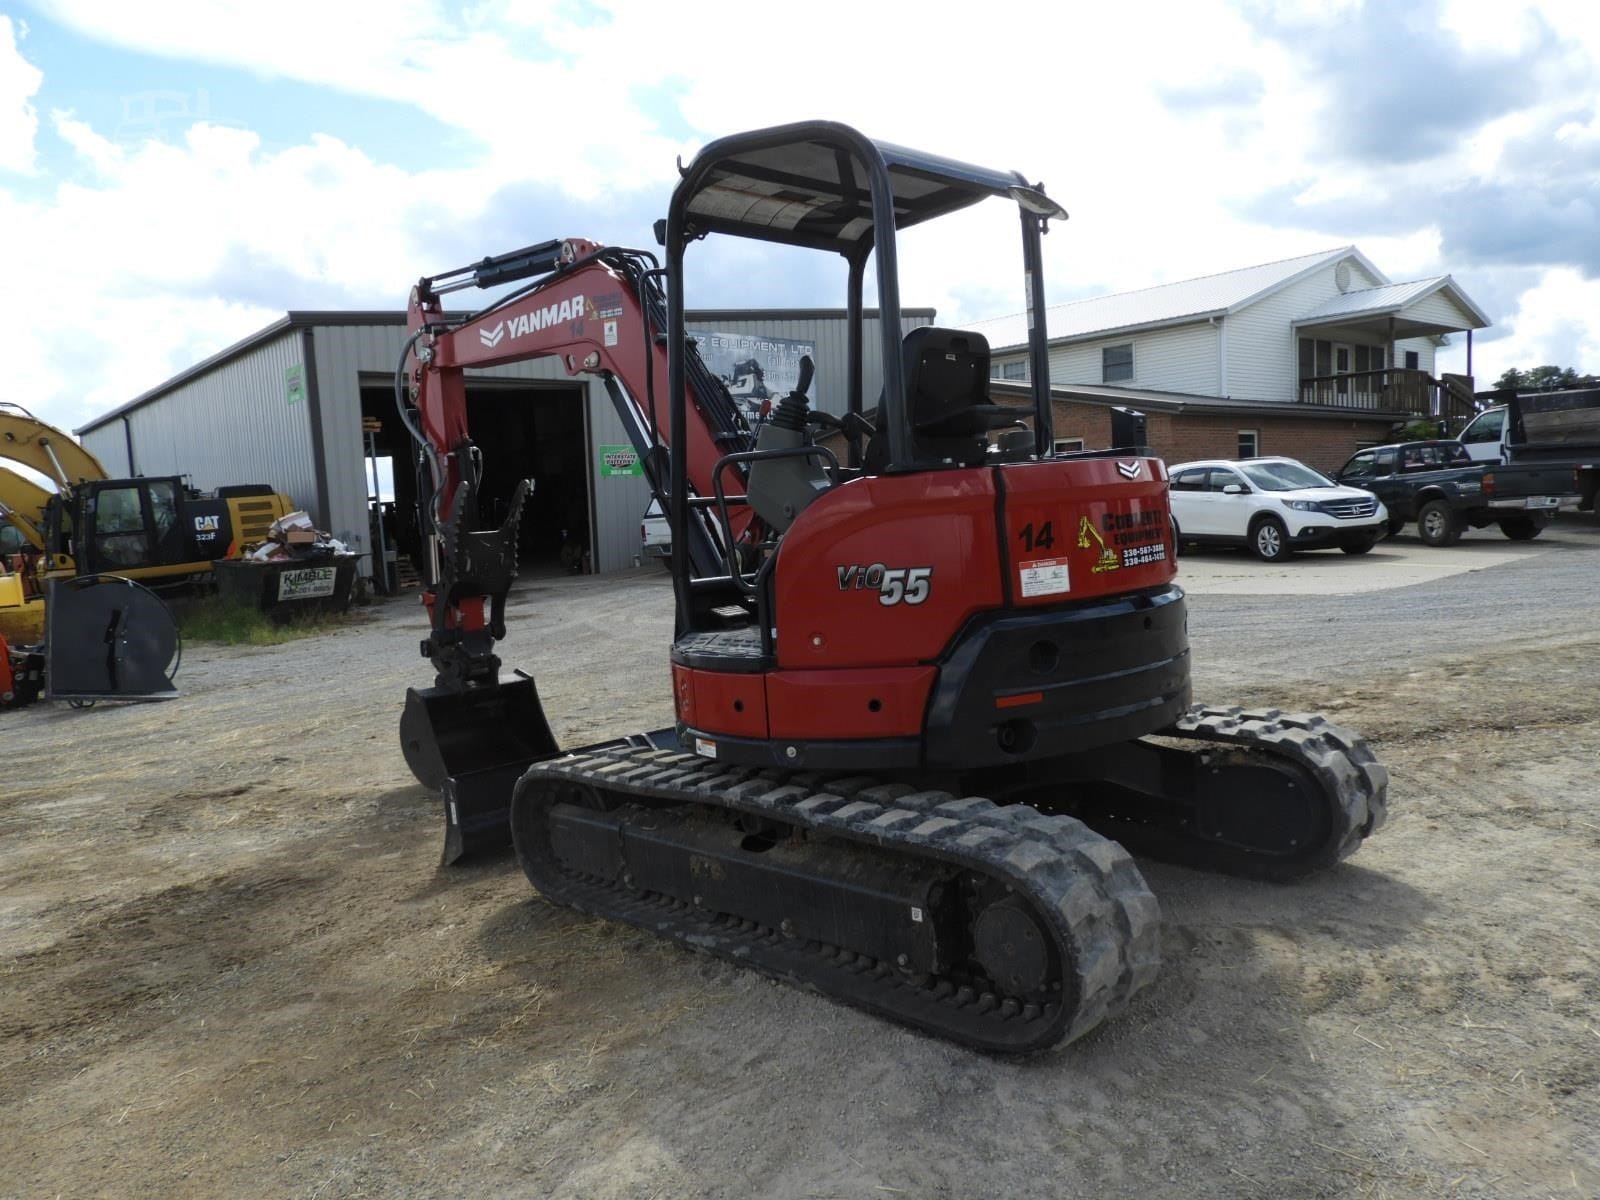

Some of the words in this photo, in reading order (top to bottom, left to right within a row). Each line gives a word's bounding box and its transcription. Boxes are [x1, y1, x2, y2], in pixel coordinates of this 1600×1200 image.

[507, 295, 585, 339] YANMAR
[791, 344, 813, 354] LTD
[194, 515, 220, 531] CAT
[1019, 520, 1055, 552] 14
[283, 568, 333, 584] KIMBLE
